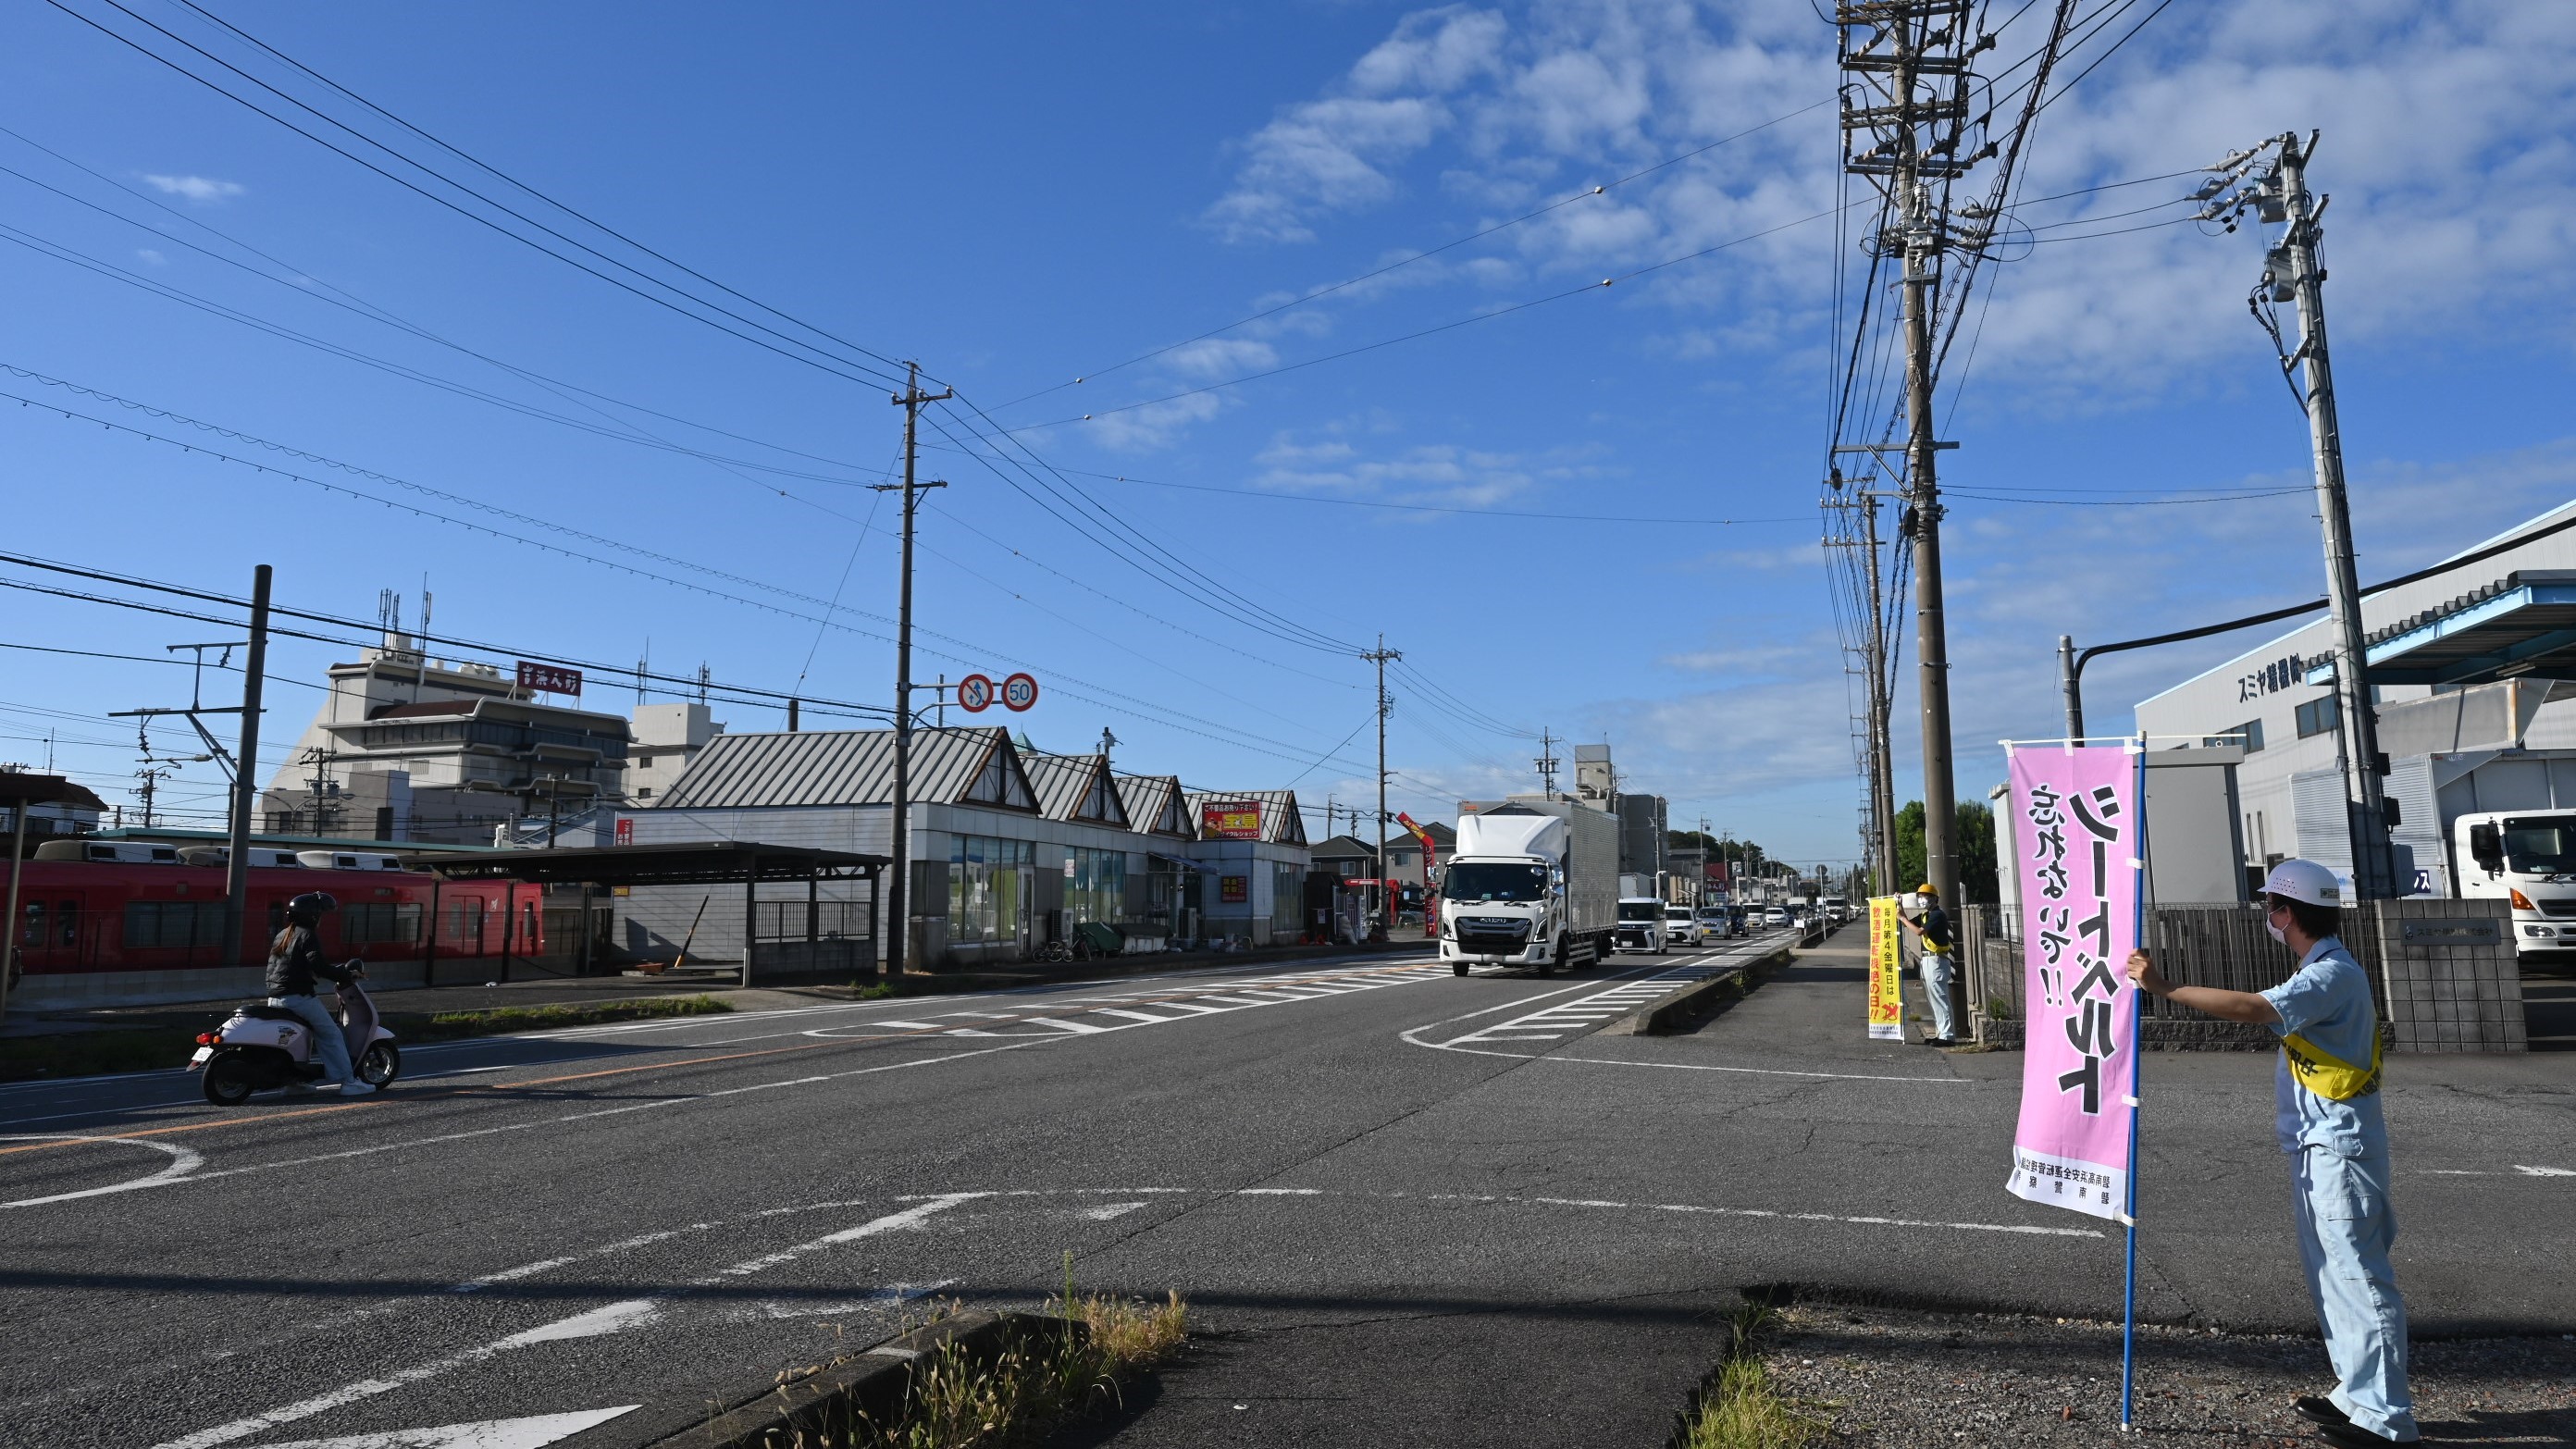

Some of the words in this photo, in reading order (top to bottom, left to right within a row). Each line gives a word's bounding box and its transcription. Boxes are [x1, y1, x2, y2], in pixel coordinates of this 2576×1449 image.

[1009, 684, 1030, 701] 50
[1883, 908, 1895, 996] 毎月第4金曜日は
